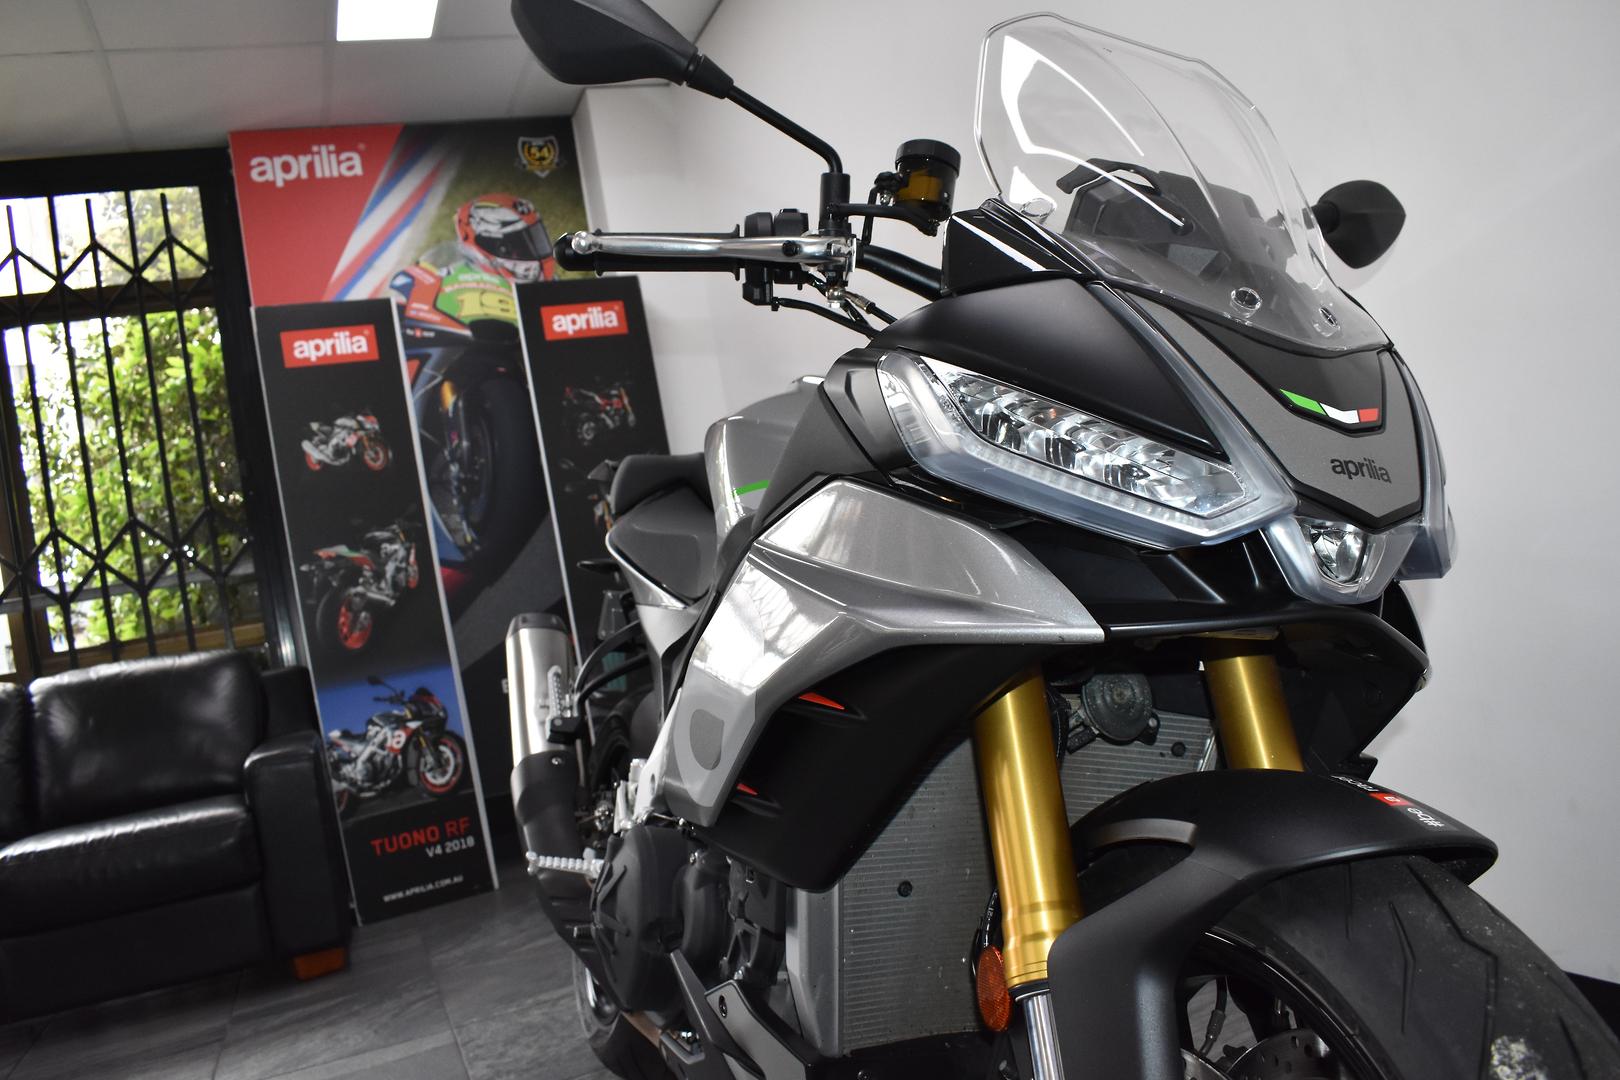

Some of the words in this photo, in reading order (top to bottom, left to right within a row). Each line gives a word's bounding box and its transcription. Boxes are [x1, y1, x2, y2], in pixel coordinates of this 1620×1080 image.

[250, 144, 363, 188] aprilia
[552, 305, 619, 335] aprilia
[293, 330, 368, 362] aprilia
[1330, 457, 1392, 483] aprilia
[370, 825, 441, 857] TUONO
[444, 816, 471, 838] RF
[425, 843, 443, 857] V4
